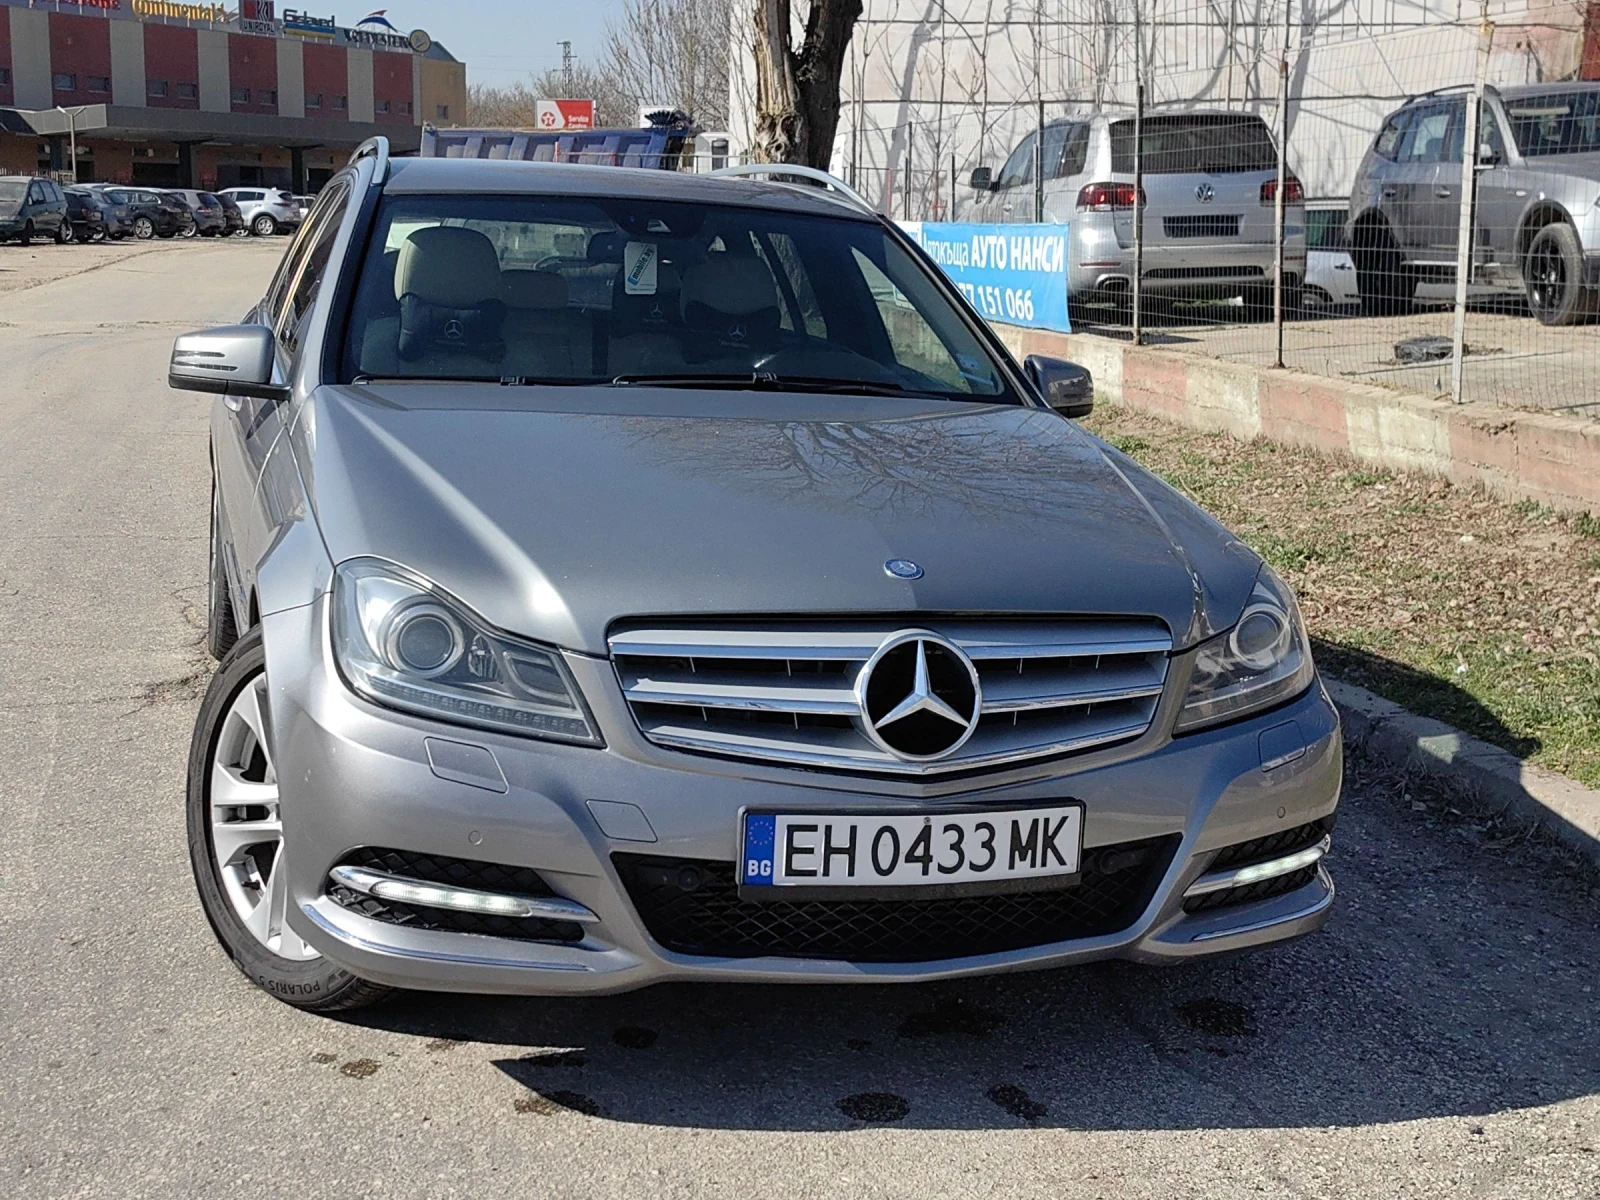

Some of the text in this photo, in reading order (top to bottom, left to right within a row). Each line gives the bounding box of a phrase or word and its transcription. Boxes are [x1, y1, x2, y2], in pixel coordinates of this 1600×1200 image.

[131, 0, 215, 22] Continental
[243, 20, 275, 33] UNIROYAL
[632, 248, 655, 280] mobile.bg
[971, 235, 1006, 269] АУТО
[1010, 236, 1065, 273] НАНСИ
[978, 285, 1003, 316] 151
[1005, 288, 1035, 321] 066
[785, 815, 1069, 877] EH 0433 MK
[747, 859, 771, 877] BG
[268, 980, 321, 995] POLARIS
